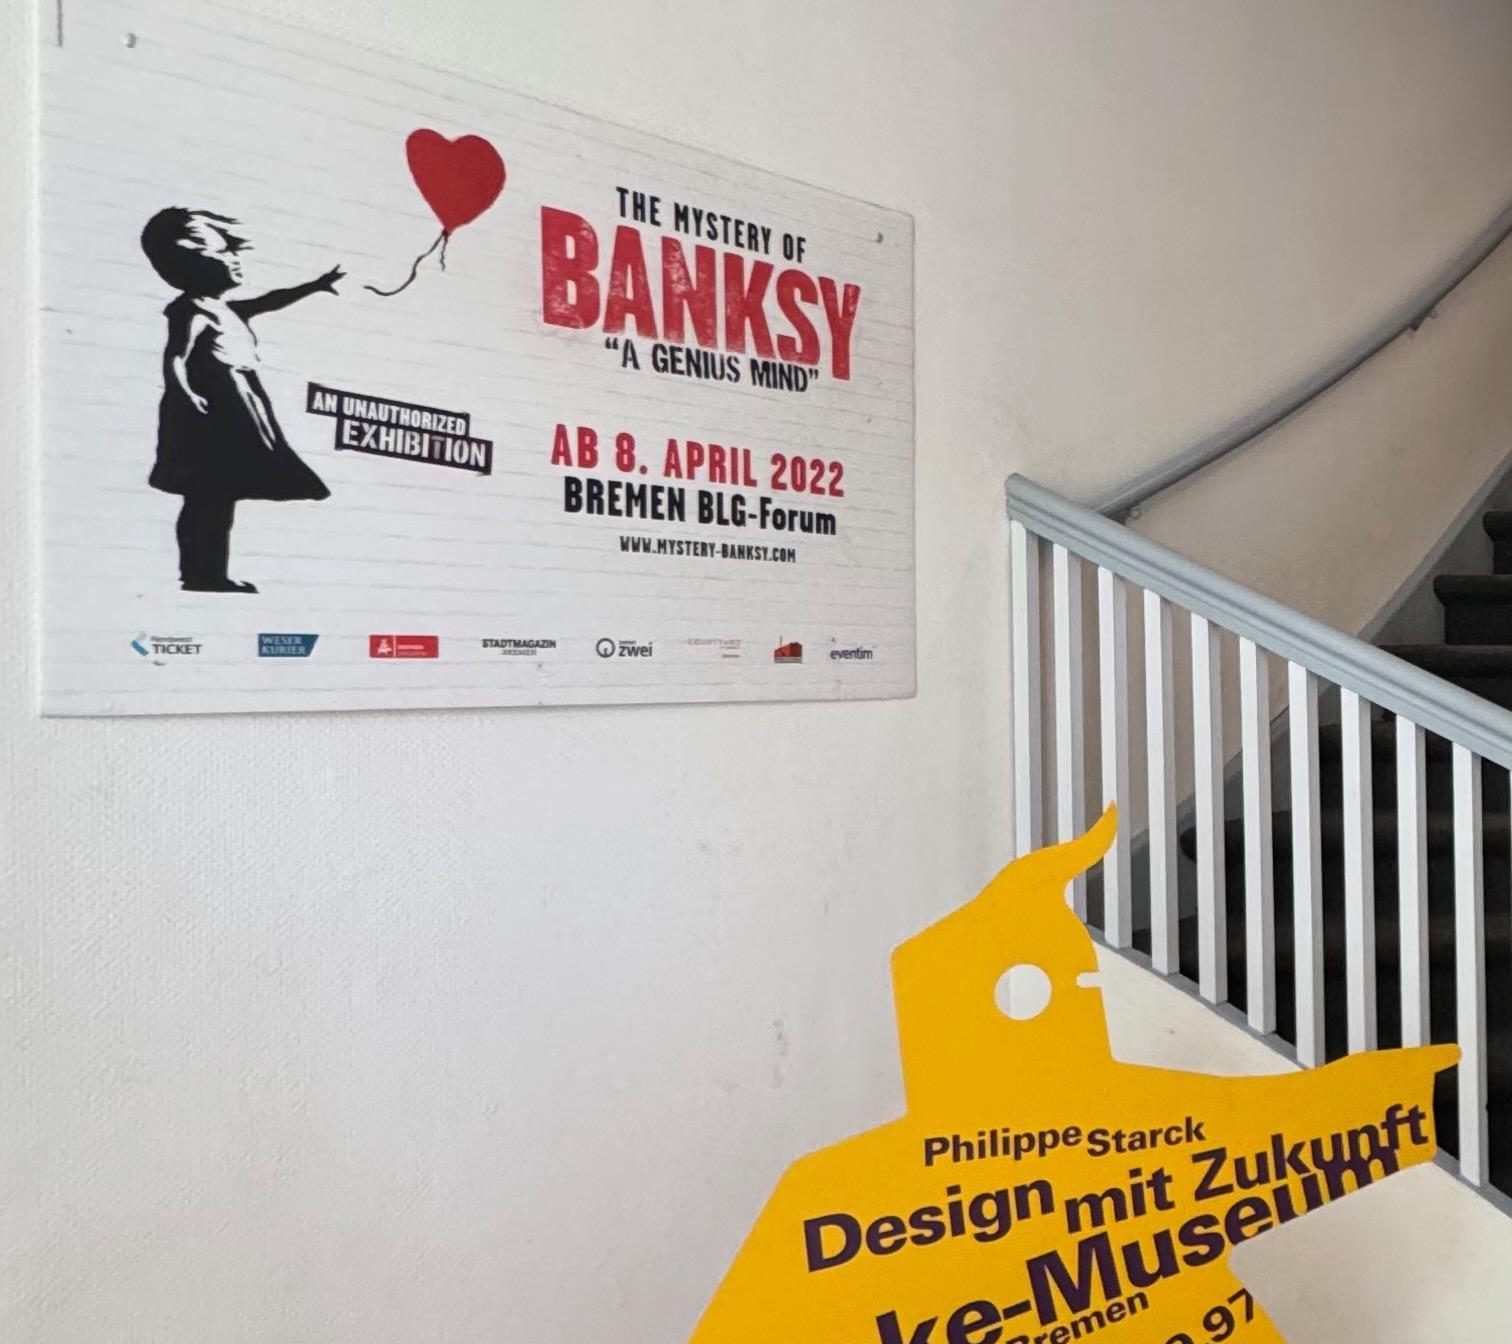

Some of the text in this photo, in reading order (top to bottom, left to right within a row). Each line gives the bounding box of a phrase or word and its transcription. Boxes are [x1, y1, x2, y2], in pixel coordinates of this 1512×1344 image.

[616, 186, 806, 264] THE MYSTERY OF
[541, 206, 861, 381] BANKSY
[652, 343, 740, 383] GENIUS
[312, 391, 466, 436] AN UNAUTHORIZED
[342, 419, 486, 468] EXHIBITION
[551, 424, 844, 497] AB 8. APRIL 2022
[564, 476, 837, 535] BREMEN BLG-Forum
[619, 536, 796, 563] WWW.MYSTERY-BANKSY.COM
[152, 643, 202, 655] TICKET
[482, 639, 556, 648] STADTMAGAZIN
[618, 641, 653, 657] zwei
[830, 647, 873, 660] eventim
[924, 1117, 1206, 1167] Philippe Starck
[804, 1103, 1429, 1272] Design mit Zukunft
